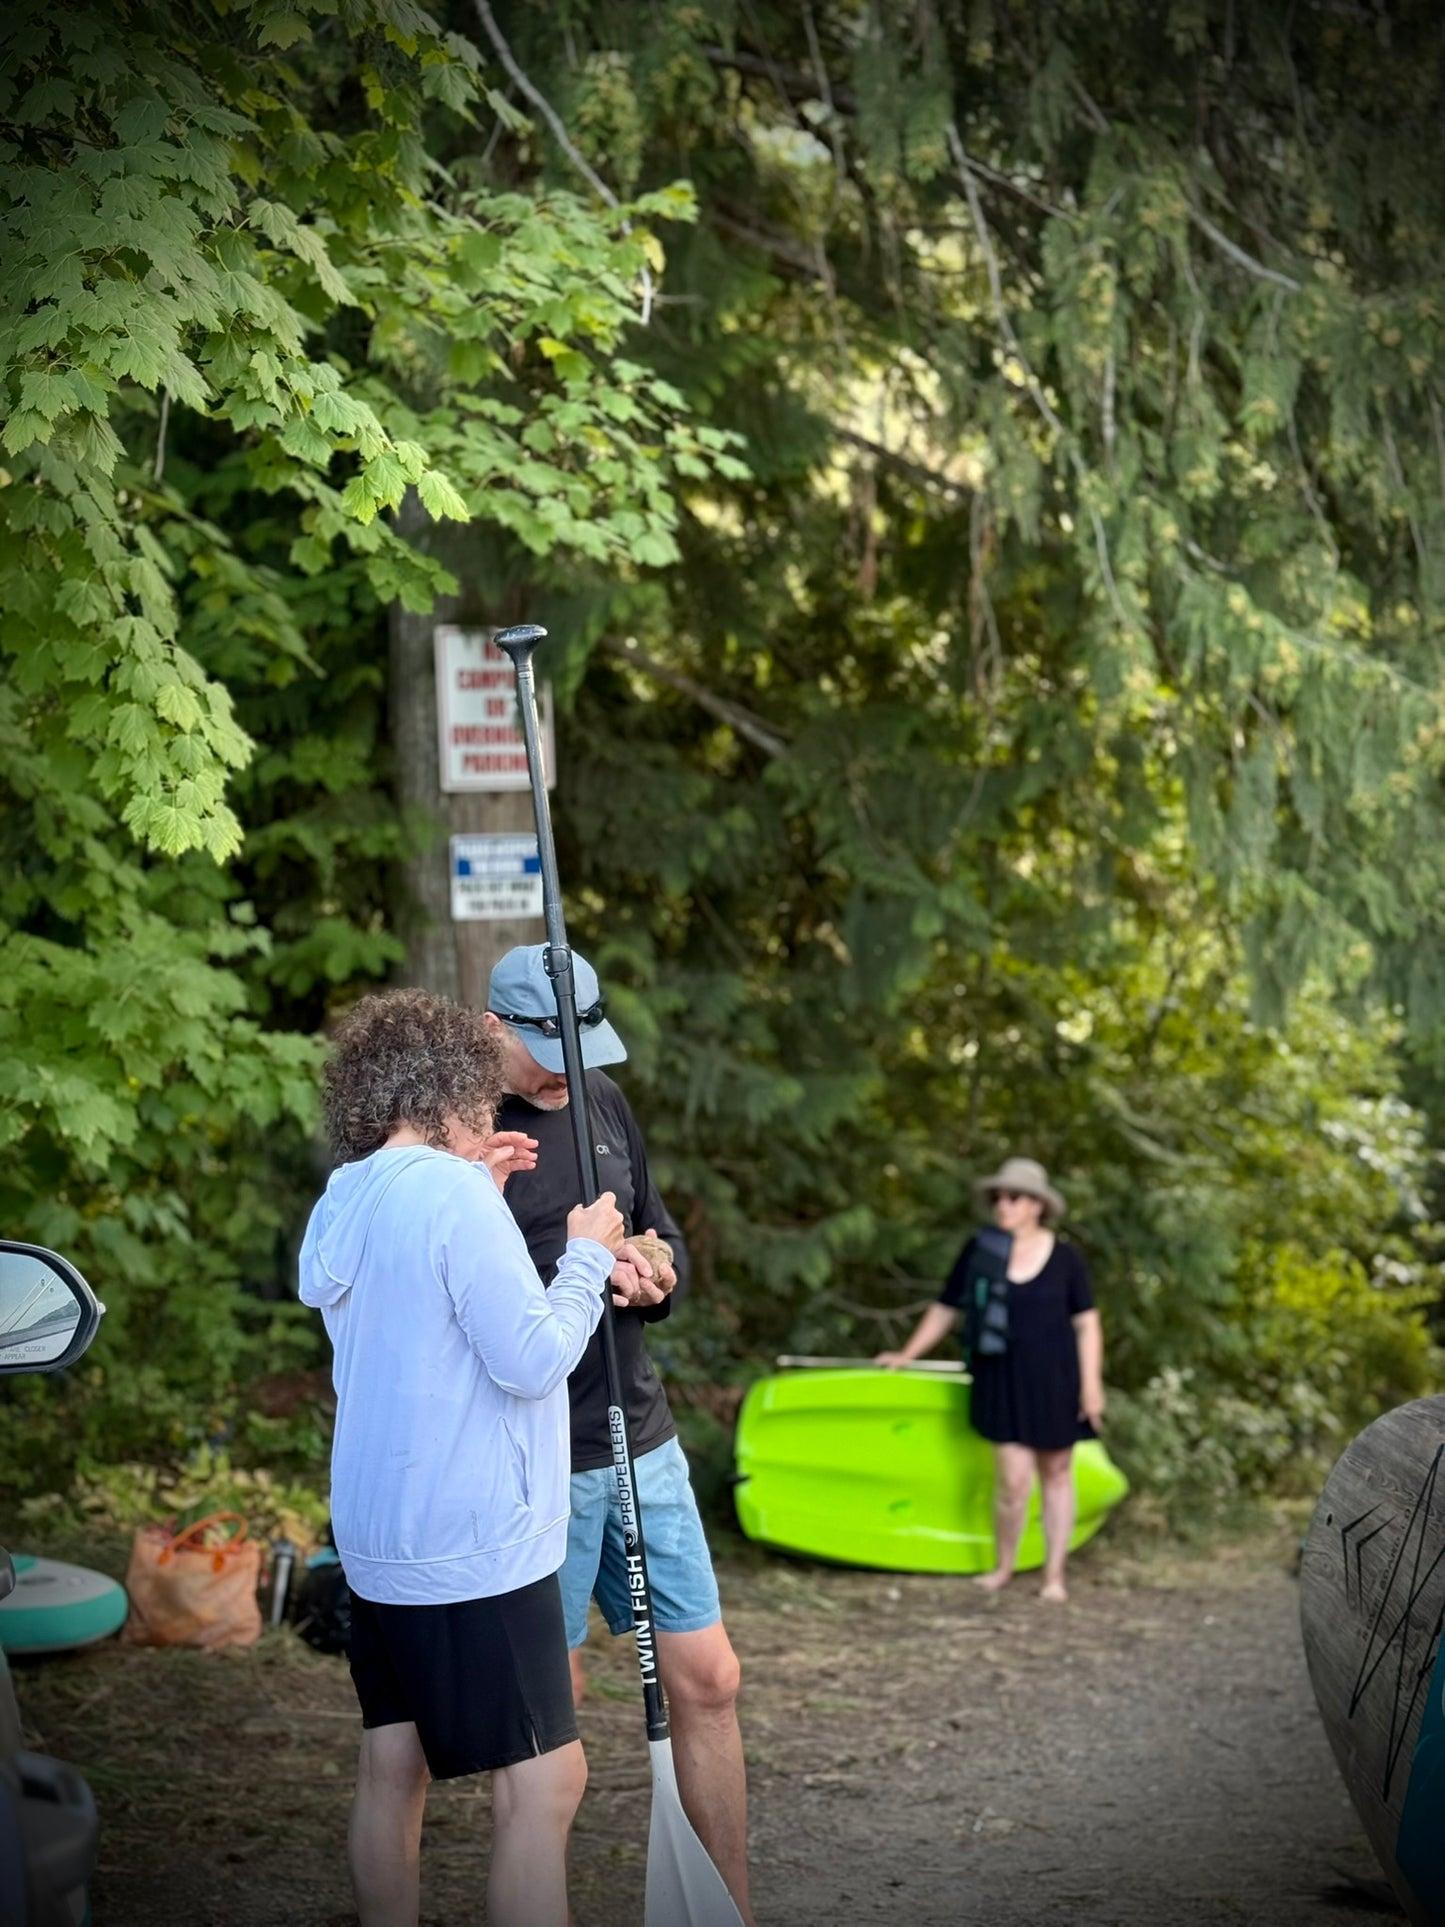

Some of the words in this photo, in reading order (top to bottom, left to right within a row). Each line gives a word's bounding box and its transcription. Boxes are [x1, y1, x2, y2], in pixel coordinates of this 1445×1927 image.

[458, 670, 518, 689] CAMPI
[609, 1410, 634, 1526] PROPELLERS
[626, 1554, 649, 1612] FISH
[1380, 1537, 1400, 1591] BOARD
[635, 1620, 657, 1688] TWIN
